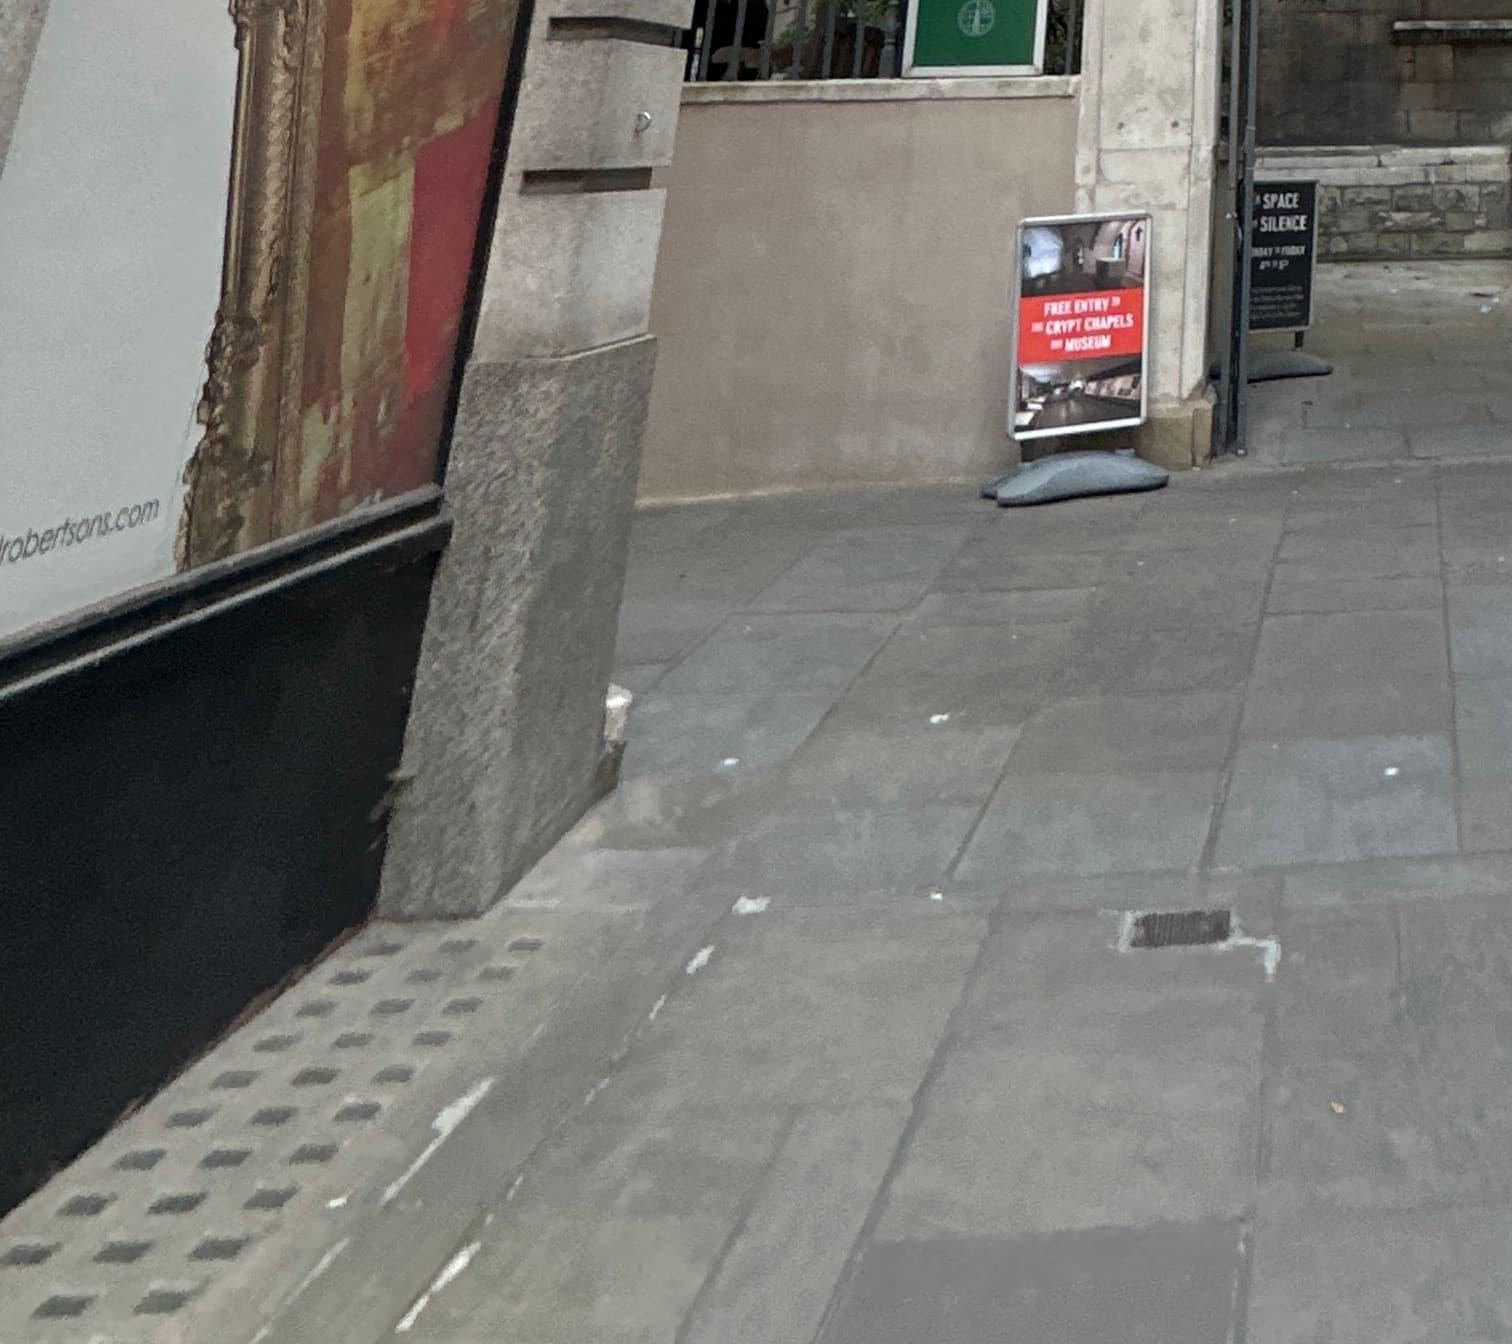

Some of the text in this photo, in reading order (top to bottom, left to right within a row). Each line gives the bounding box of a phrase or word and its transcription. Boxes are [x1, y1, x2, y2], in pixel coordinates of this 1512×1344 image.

[1262, 192, 1300, 209] SPACE
[1260, 215, 1308, 232] SILENCE
[1044, 300, 1073, 317] FREE
[1074, 297, 1110, 313] ENTRY
[1045, 318, 1083, 335] CRYPT
[1084, 313, 1134, 331] CHAPELS
[1064, 335, 1112, 352] MUSEUM
